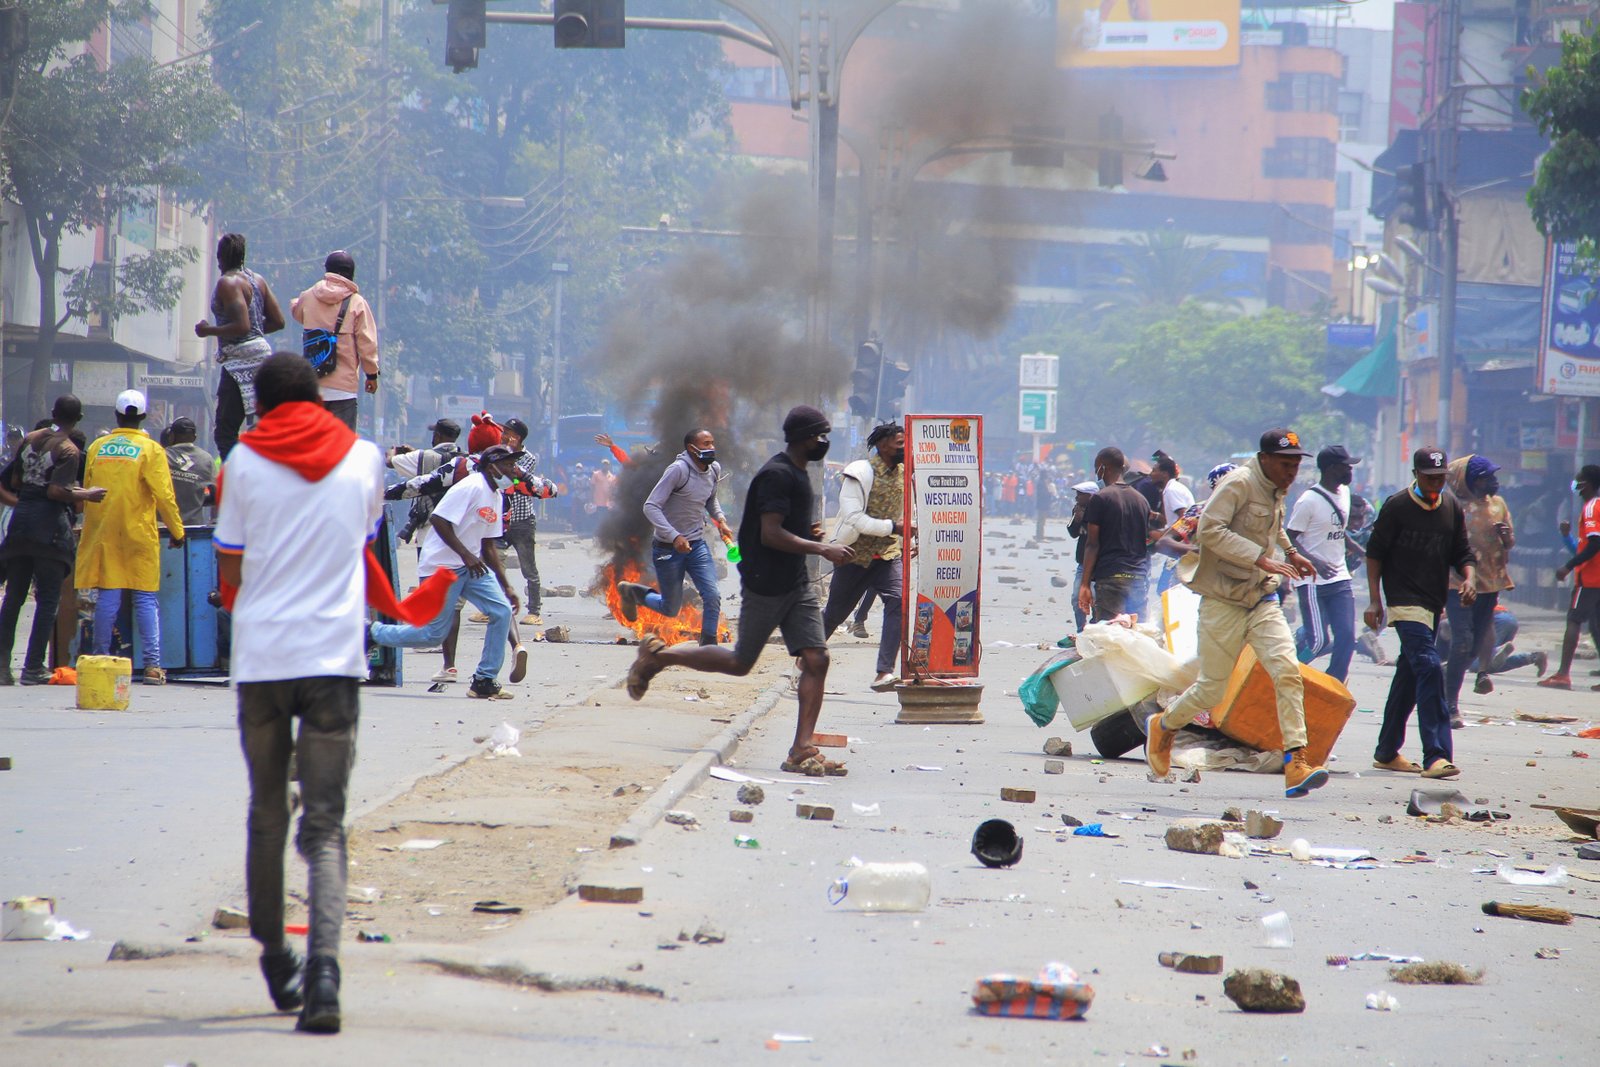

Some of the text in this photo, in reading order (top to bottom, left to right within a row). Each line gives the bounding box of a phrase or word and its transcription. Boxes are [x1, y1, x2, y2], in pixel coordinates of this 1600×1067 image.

[179, 377, 203, 386] STREET
[922, 424, 950, 439] ROUTE
[100, 444, 137, 456] SOKO
[918, 442, 936, 452] KMO
[916, 454, 941, 464] SACCO
[944, 454, 977, 464] LUXURY LTD
[1430, 452, 1443, 467] T
[925, 493, 973, 506] WESTLANDS
[932, 511, 967, 524] KANGEMI
[935, 530, 964, 542] UTHIRU
[937, 548, 961, 561] KINOO
[936, 567, 961, 580] REGEN
[933, 586, 961, 599] KIKUYU
